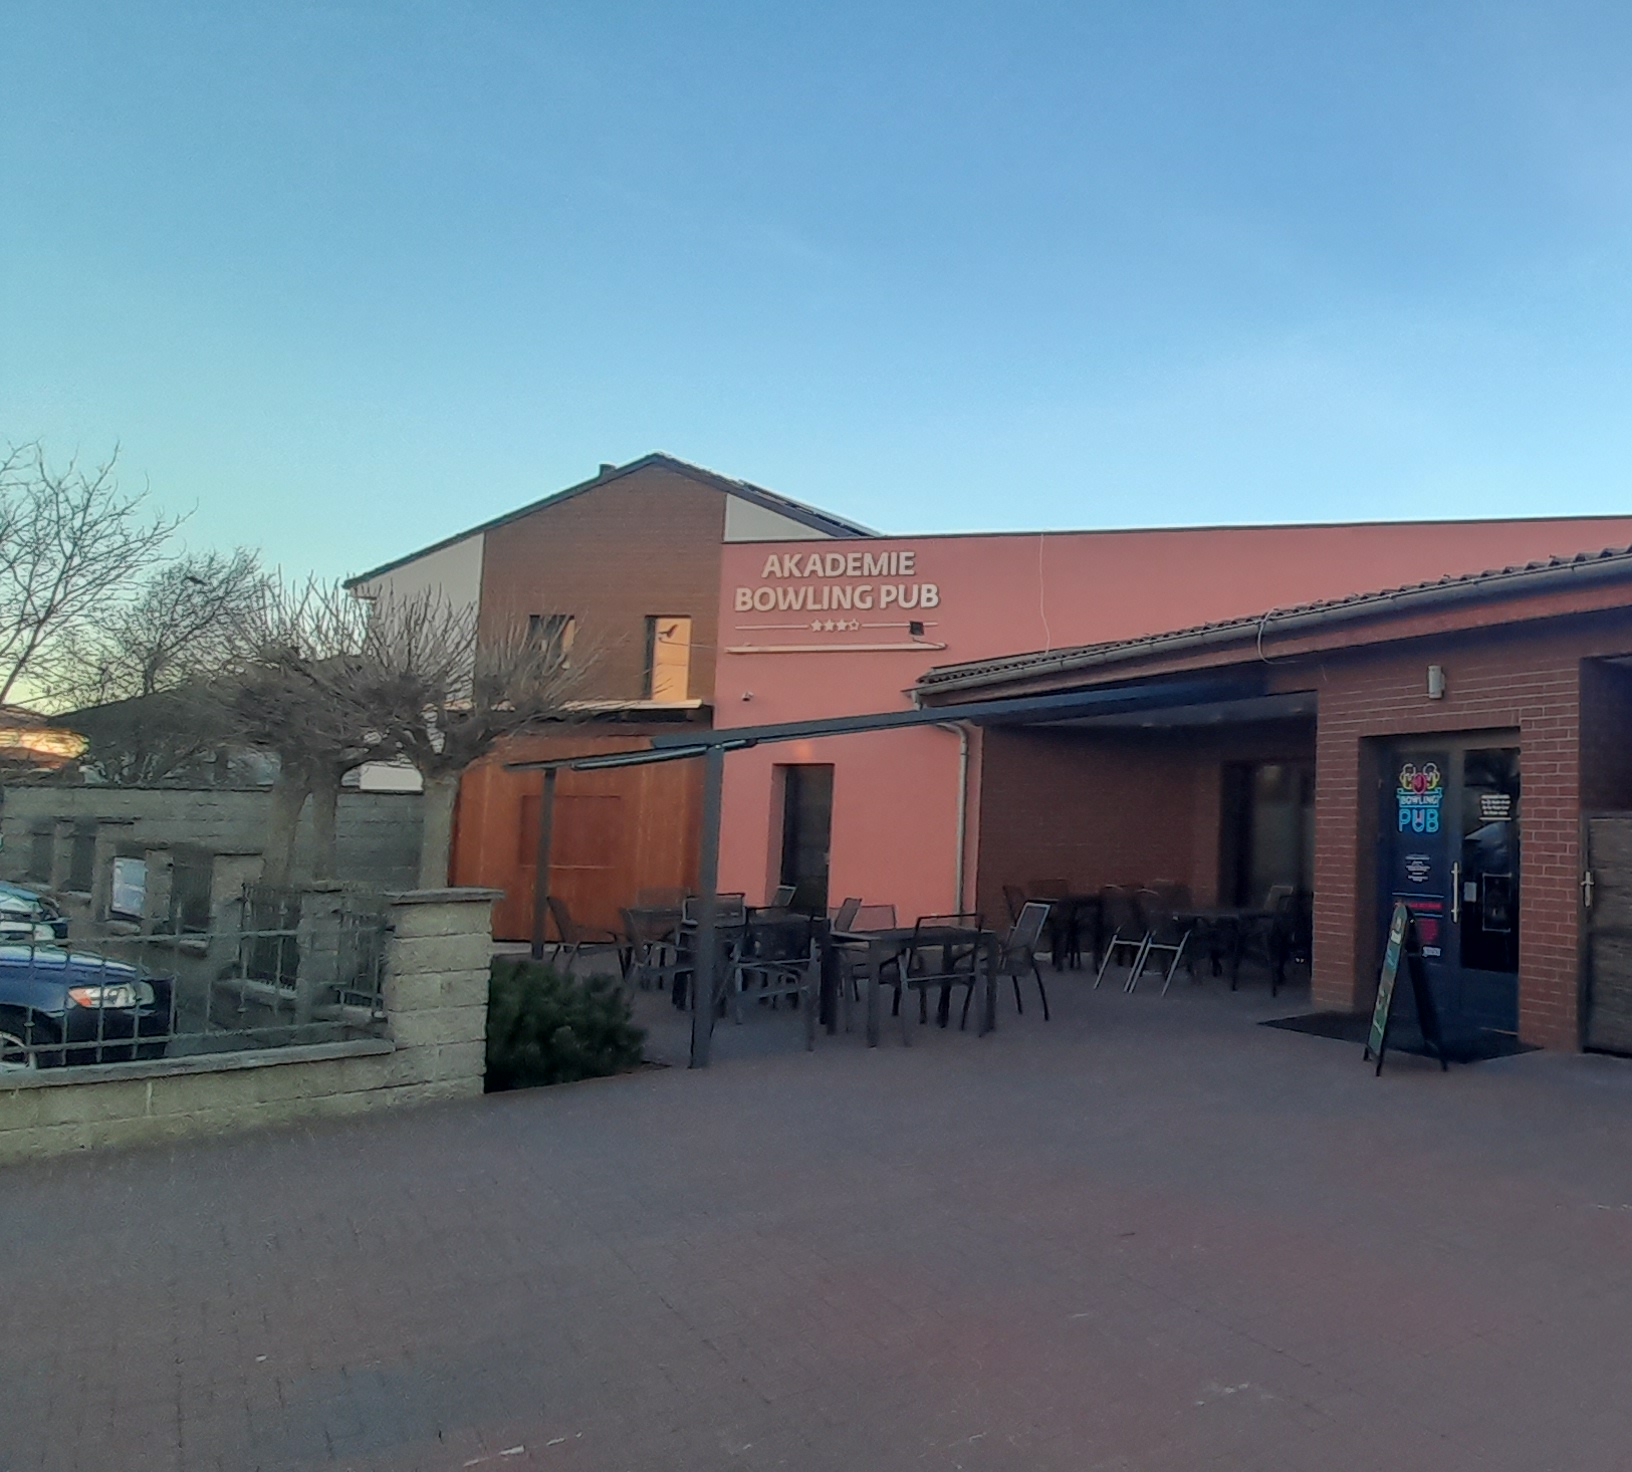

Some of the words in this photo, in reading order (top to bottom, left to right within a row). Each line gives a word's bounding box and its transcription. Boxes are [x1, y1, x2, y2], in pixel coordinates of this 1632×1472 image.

[761, 551, 915, 578] AKADEMIE
[735, 584, 873, 611] BOWLING
[879, 583, 939, 609] PUB
[1400, 795, 1439, 805] BOWLING
[1399, 808, 1439, 833] PUB
